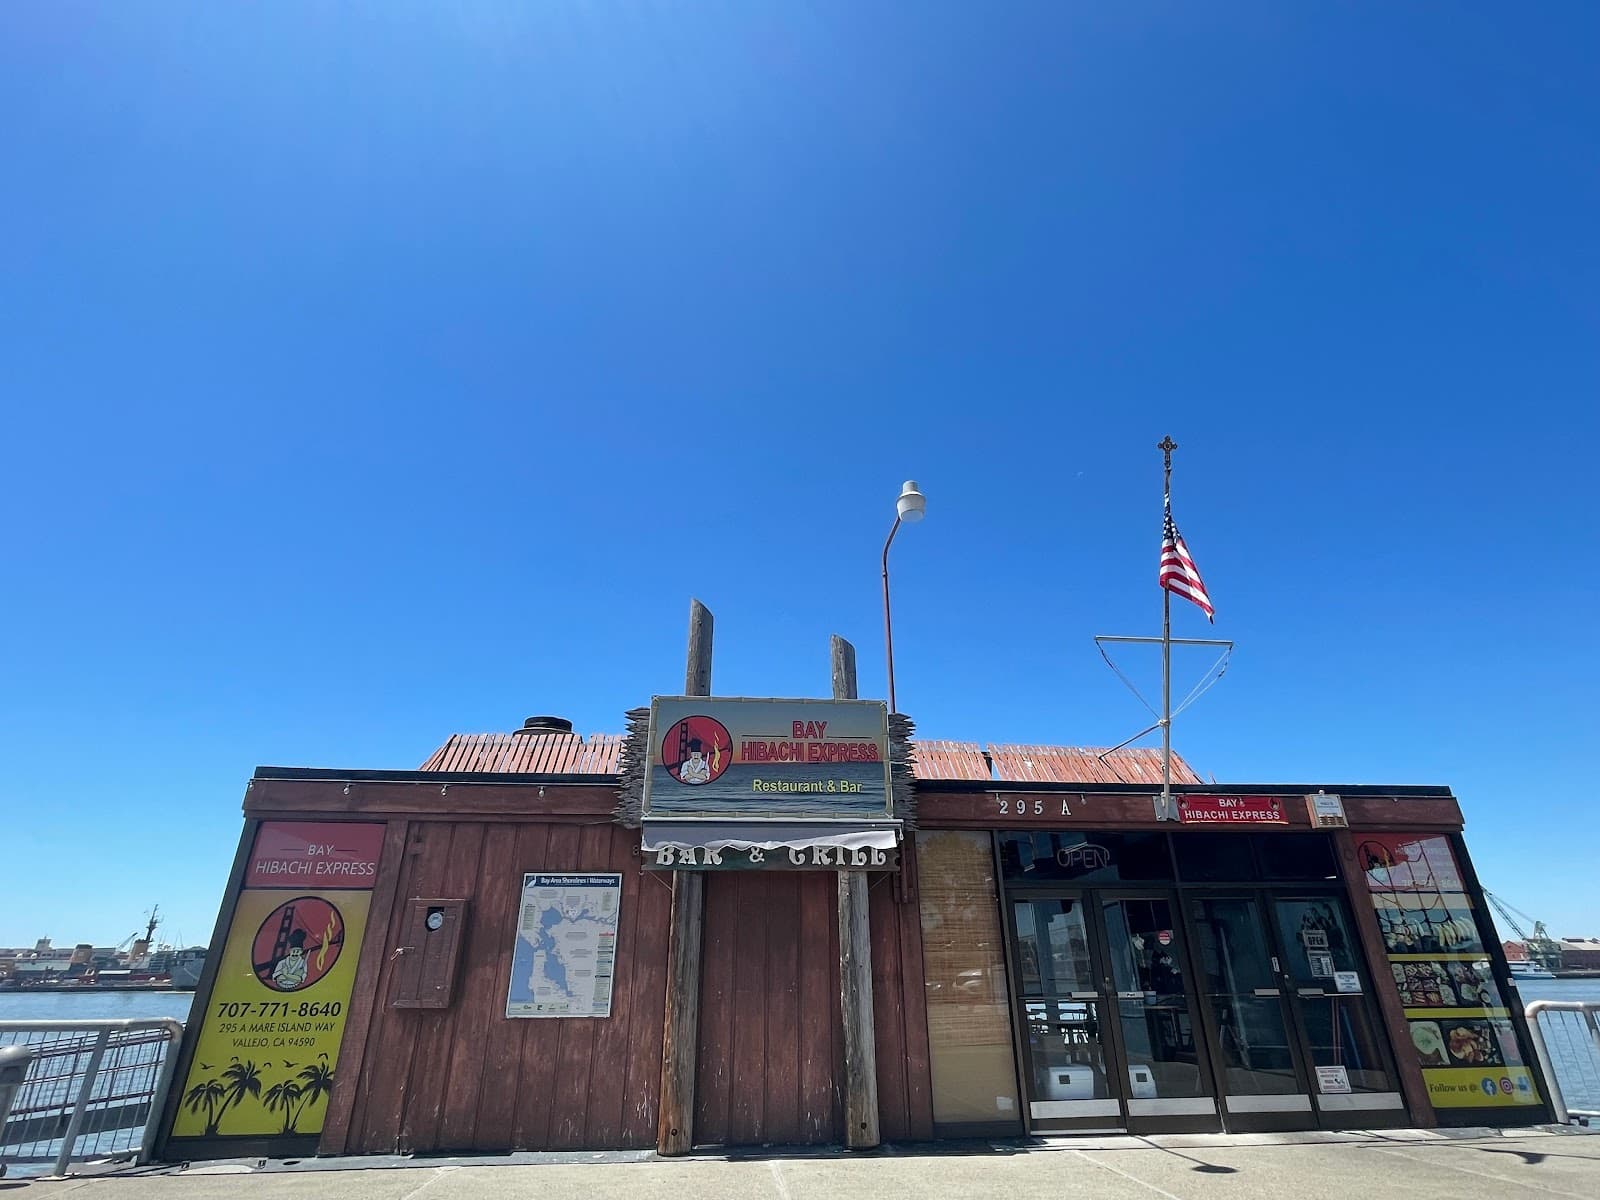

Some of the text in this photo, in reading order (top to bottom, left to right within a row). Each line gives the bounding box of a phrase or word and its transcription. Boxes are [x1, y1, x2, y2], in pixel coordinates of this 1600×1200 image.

[792, 720, 828, 739] BAY
[741, 741, 878, 762] HIBACHI EXPRESS
[753, 779, 863, 793] Restaurant & Bar
[999, 799, 1071, 815] 295 A
[1218, 799, 1238, 808] BAY
[1184, 810, 1281, 820] HIBACHI EXPRESS
[306, 843, 335, 856] BAY
[656, 847, 722, 866] BAR
[749, 846, 765, 863] &
[255, 860, 376, 876] HIBACHI EXPRESS
[217, 1001, 343, 1018] 707-771-8640
[219, 1021, 336, 1034] 295 A MARE ISLAND WAY
[232, 1037, 316, 1049] VALLEJO, CA 94590
[1430, 1083, 1457, 1094] Follow
[1458, 1085, 1468, 1093] us
